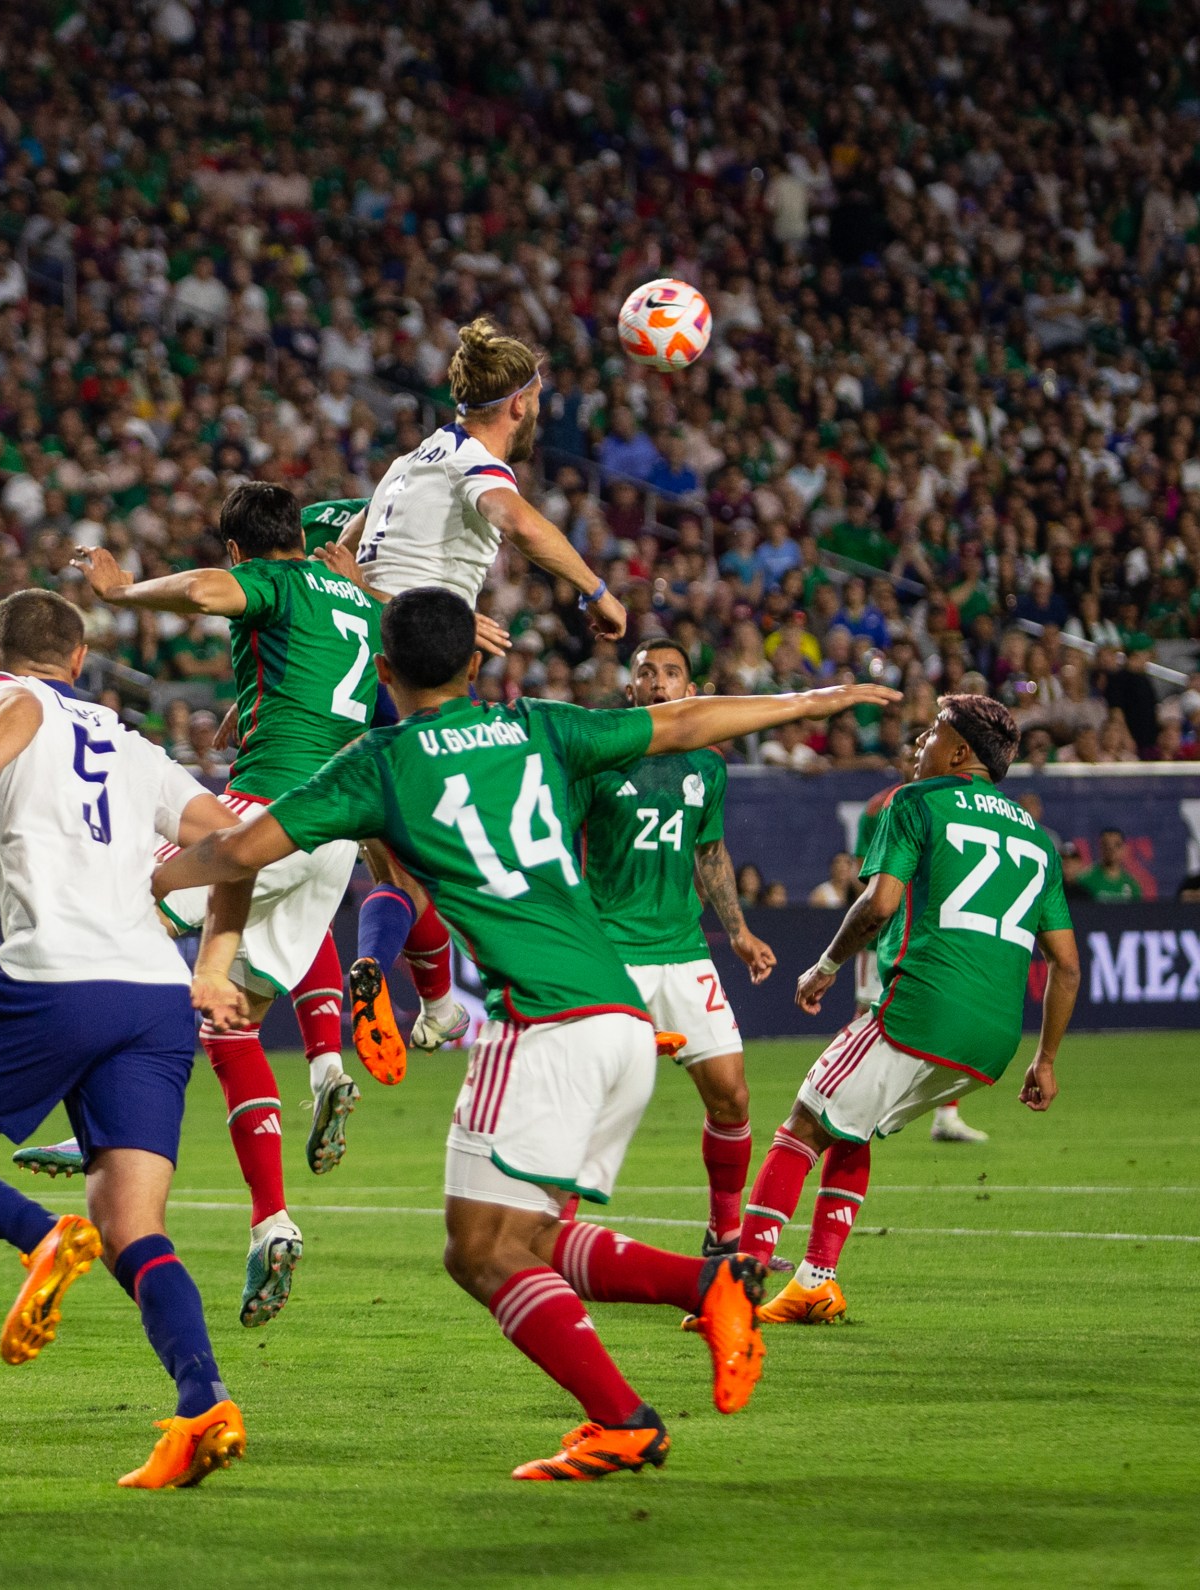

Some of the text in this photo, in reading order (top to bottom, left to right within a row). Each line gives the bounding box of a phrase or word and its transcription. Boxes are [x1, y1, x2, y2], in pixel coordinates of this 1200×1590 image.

[331, 608, 370, 723] 2
[72, 721, 117, 846] 5
[432, 753, 580, 899] 14
[634, 808, 684, 851] 24
[939, 822, 1049, 955] 22
